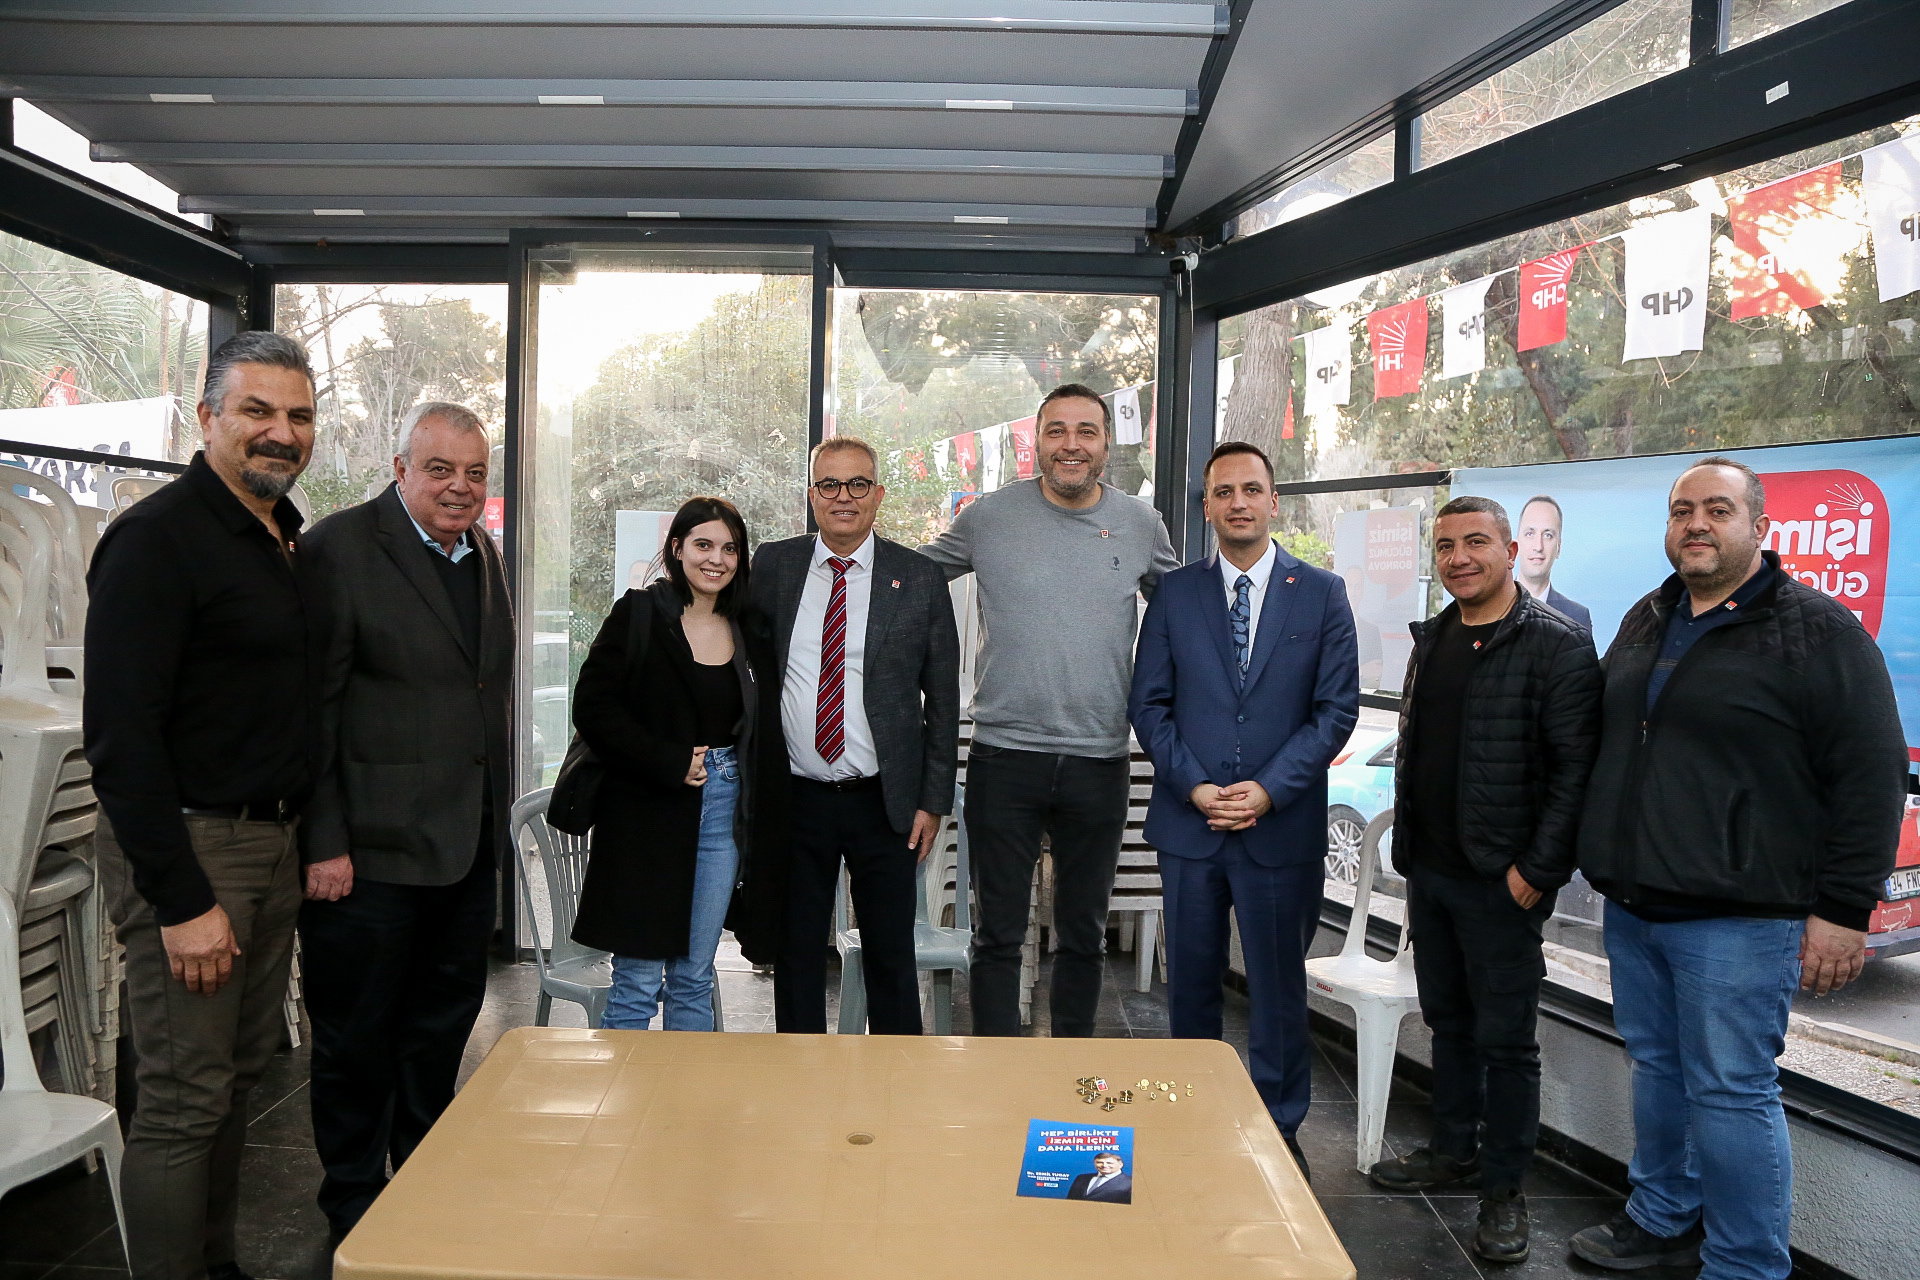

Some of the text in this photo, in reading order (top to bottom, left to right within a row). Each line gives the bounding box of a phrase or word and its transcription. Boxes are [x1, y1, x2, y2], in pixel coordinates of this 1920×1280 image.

[1890, 875, 1903, 891] 34
[1049, 1136, 1111, 1145] İZMİR İÇİN
